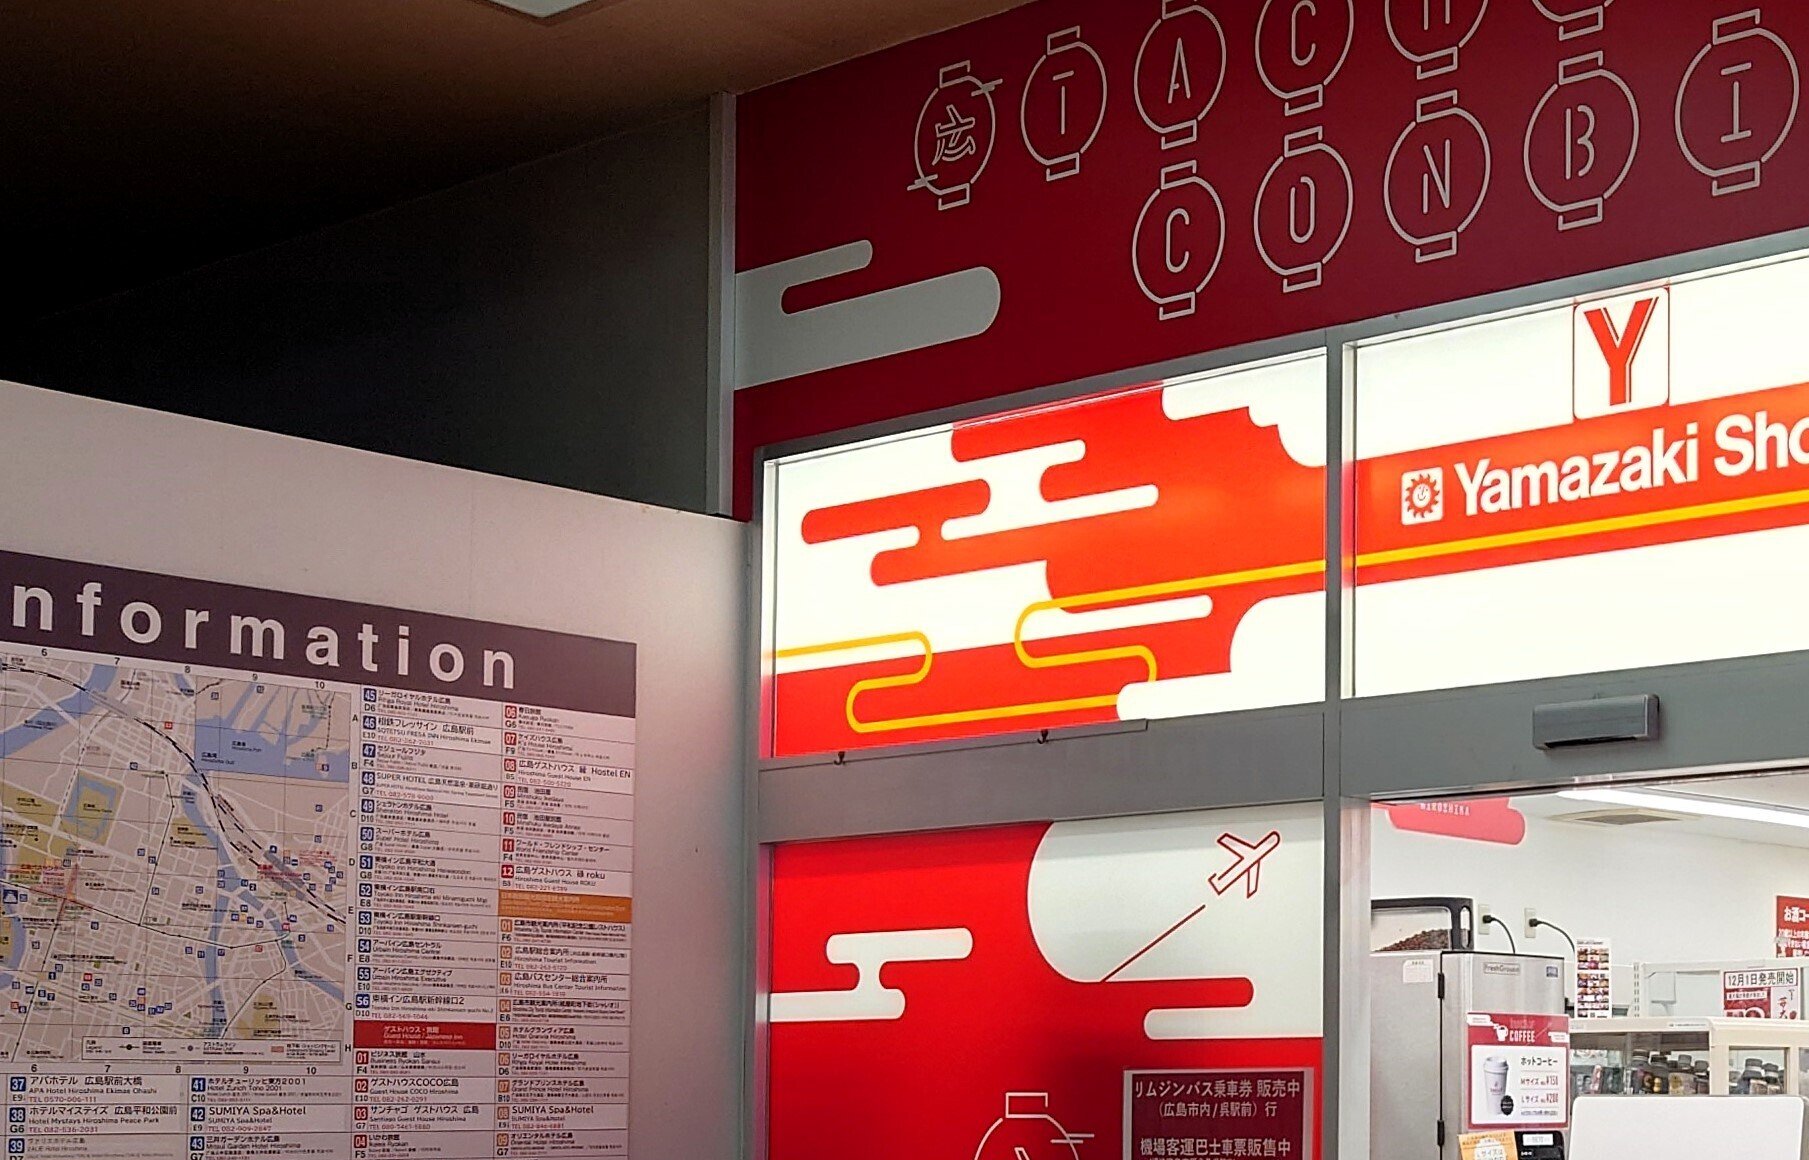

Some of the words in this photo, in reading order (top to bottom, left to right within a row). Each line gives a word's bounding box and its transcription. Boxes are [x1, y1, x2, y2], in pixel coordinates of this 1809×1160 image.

[1584, 297, 1659, 407] Y
[1453, 421, 1699, 517] Yamazaki
[12, 582, 517, 691] nformation
[363, 715, 376, 730] 46
[591, 767, 618, 778] Hostel
[619, 769, 631, 779] EN
[586, 871, 606, 880] roku
[1728, 970, 1795, 987] 12月1日発売開始
[356, 994, 370, 1008] 56
[1509, 1030, 1536, 1043] COFFEE
[11, 1077, 26, 1092] 37
[355, 1079, 368, 1093] 02
[1135, 1079, 1252, 1098] リムジンバス乗車券
[1256, 1079, 1300, 1097] 販売中
[9, 1107, 25, 1123] 38
[191, 1107, 206, 1122] 42
[208, 1107, 250, 1116] SUMIYA
[253, 1106, 307, 1117] Spa&Hotel
[413, 1105, 459, 1114] ゲストハウス
[512, 1105, 547, 1115] SUMIYA
[549, 1105, 595, 1115] Spa&Hotel
[1264, 1101, 1277, 1117] 行
